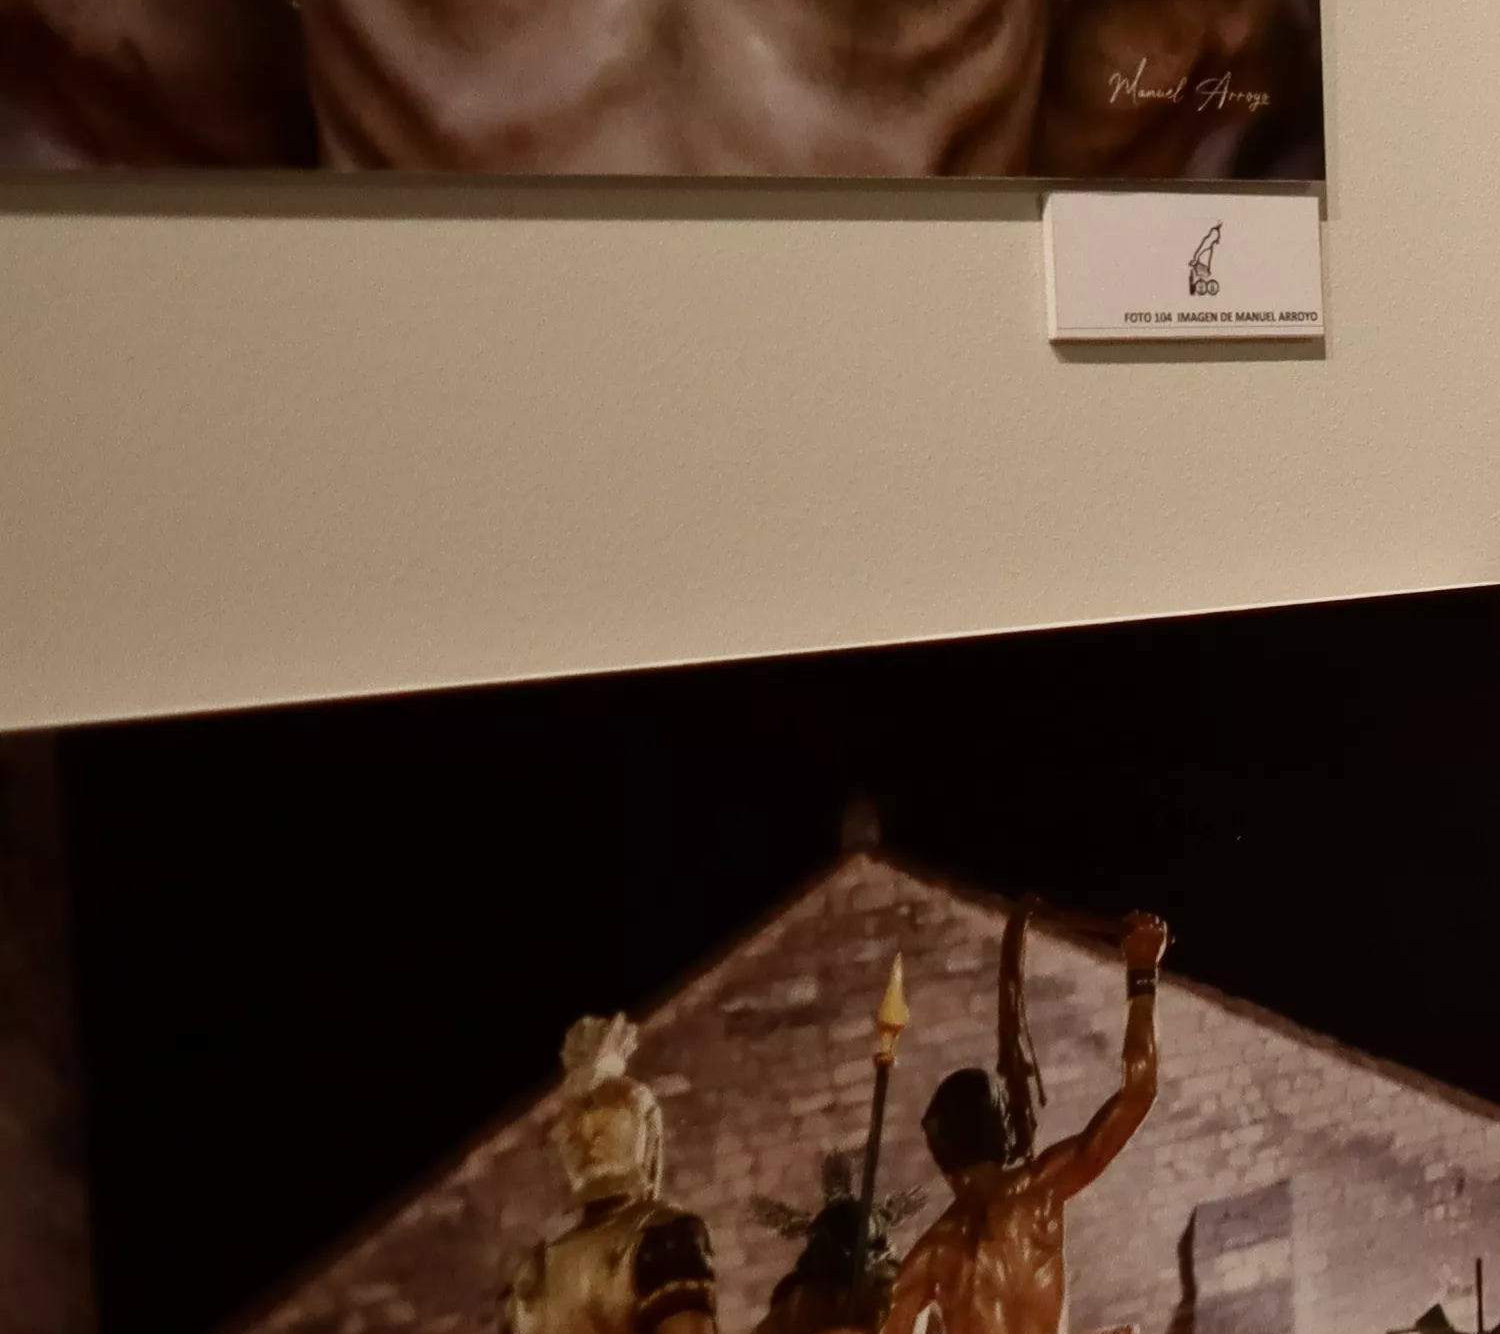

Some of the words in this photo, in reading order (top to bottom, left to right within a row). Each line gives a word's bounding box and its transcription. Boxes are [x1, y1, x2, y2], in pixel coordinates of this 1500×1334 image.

[1108, 57, 1188, 105] Manuel
[1124, 312, 1151, 323] FOTO
[1154, 312, 1173, 323] 104
[1177, 311, 1219, 323] IMAGEN
[1220, 311, 1233, 323] DE
[1235, 311, 1276, 322] MANUEL
[1278, 311, 1318, 322] ARROYO
